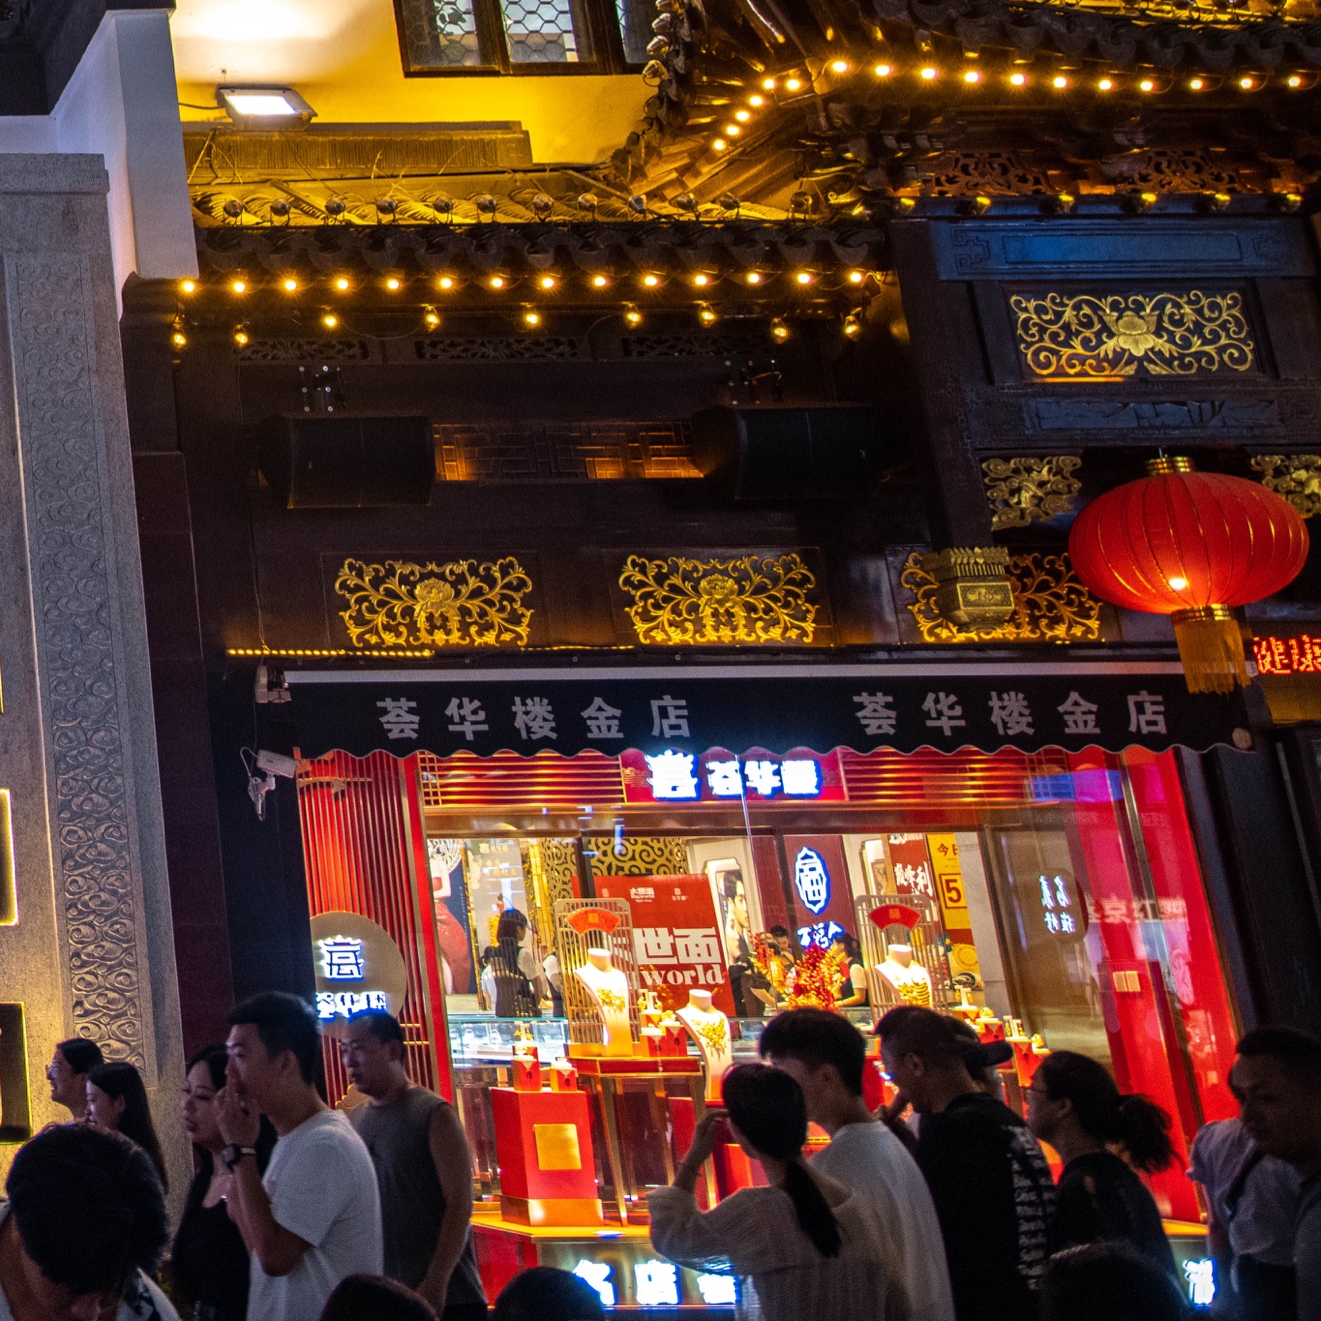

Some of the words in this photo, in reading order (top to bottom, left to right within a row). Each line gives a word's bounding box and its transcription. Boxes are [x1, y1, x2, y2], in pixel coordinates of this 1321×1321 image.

[376, 694, 692, 740] 荟华楼金店
[852, 690, 1167, 737] 荟华楼金店
